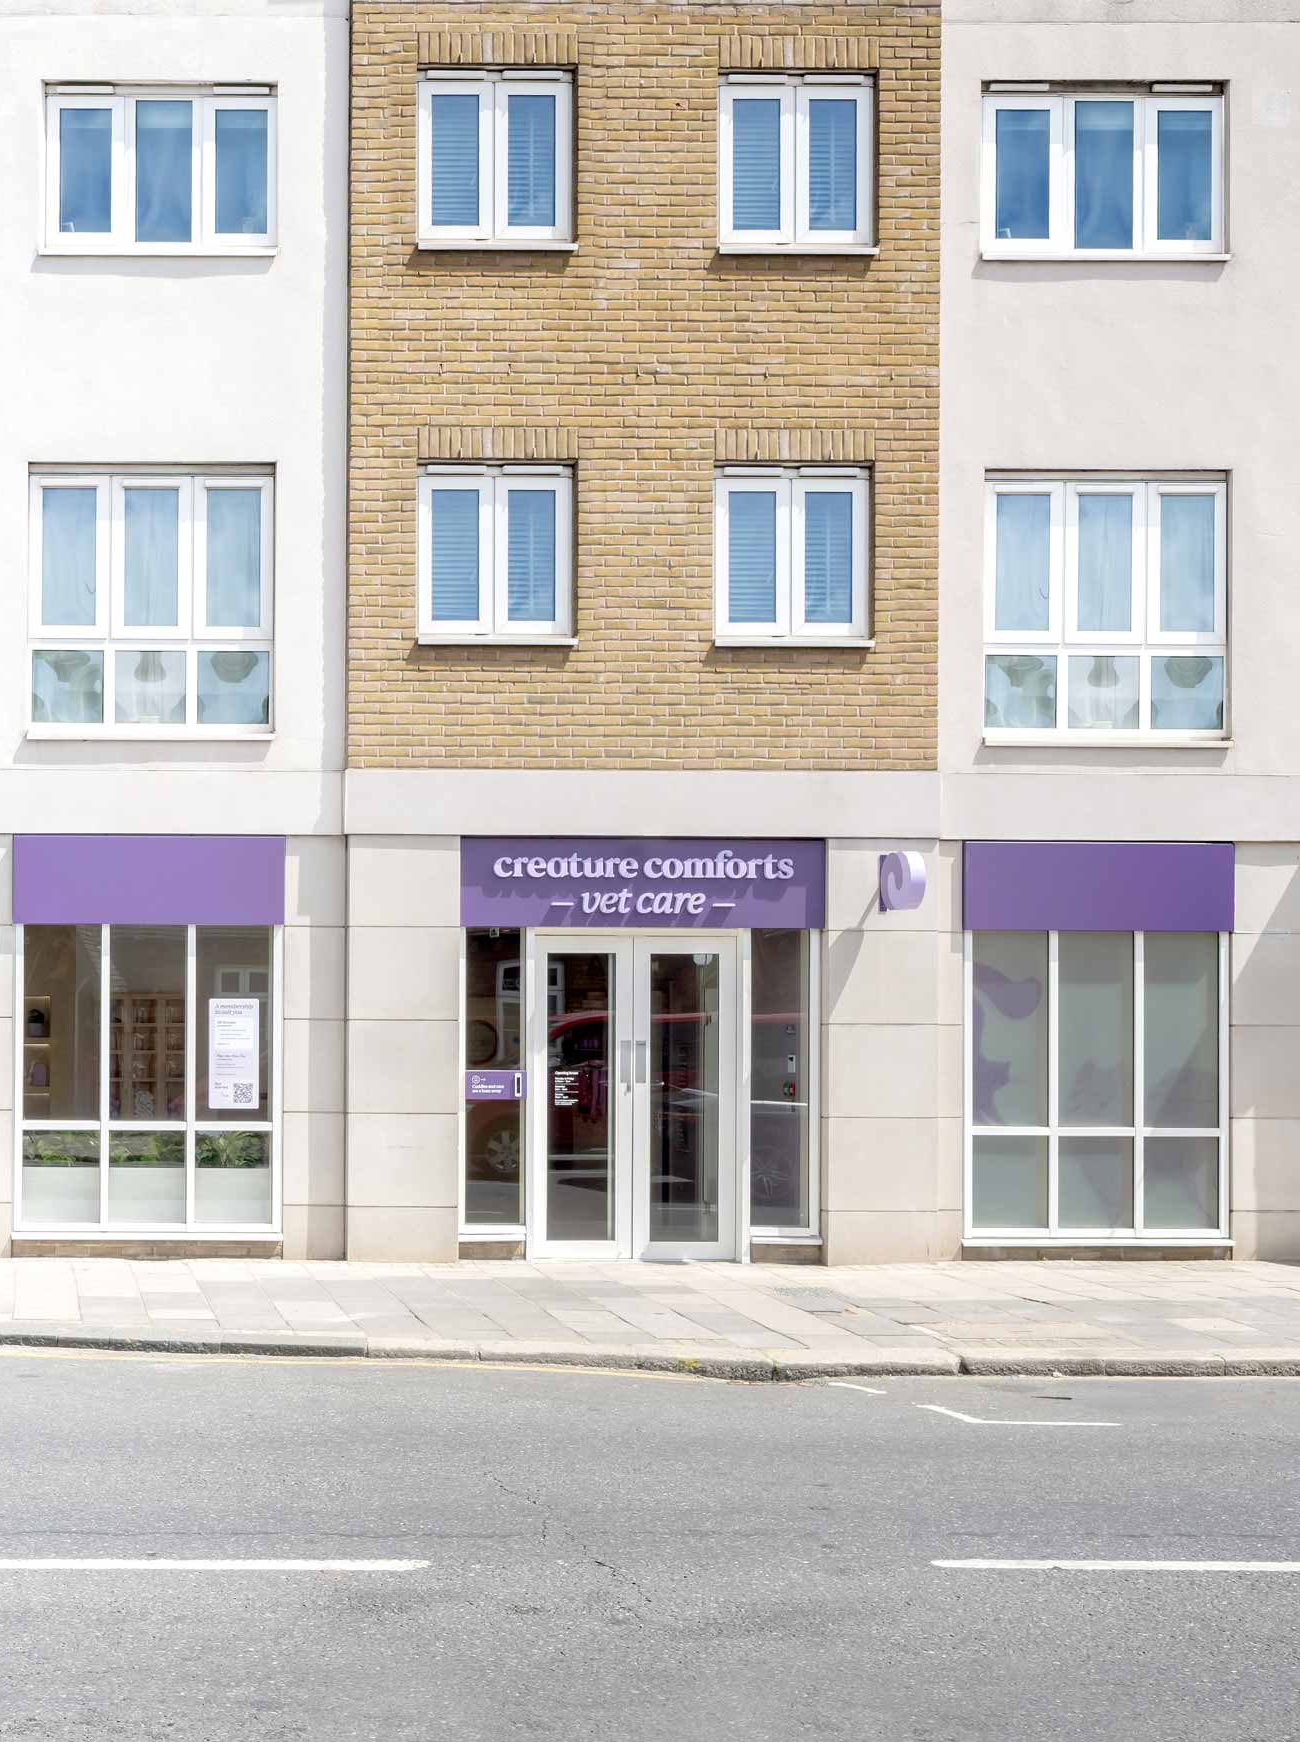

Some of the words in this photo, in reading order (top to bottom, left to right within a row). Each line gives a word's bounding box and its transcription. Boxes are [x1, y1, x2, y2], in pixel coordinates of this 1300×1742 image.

[493, 852, 639, 879] creature
[643, 849, 794, 880] comforts
[581, 888, 632, 914] vet
[636, 892, 707, 914] care
